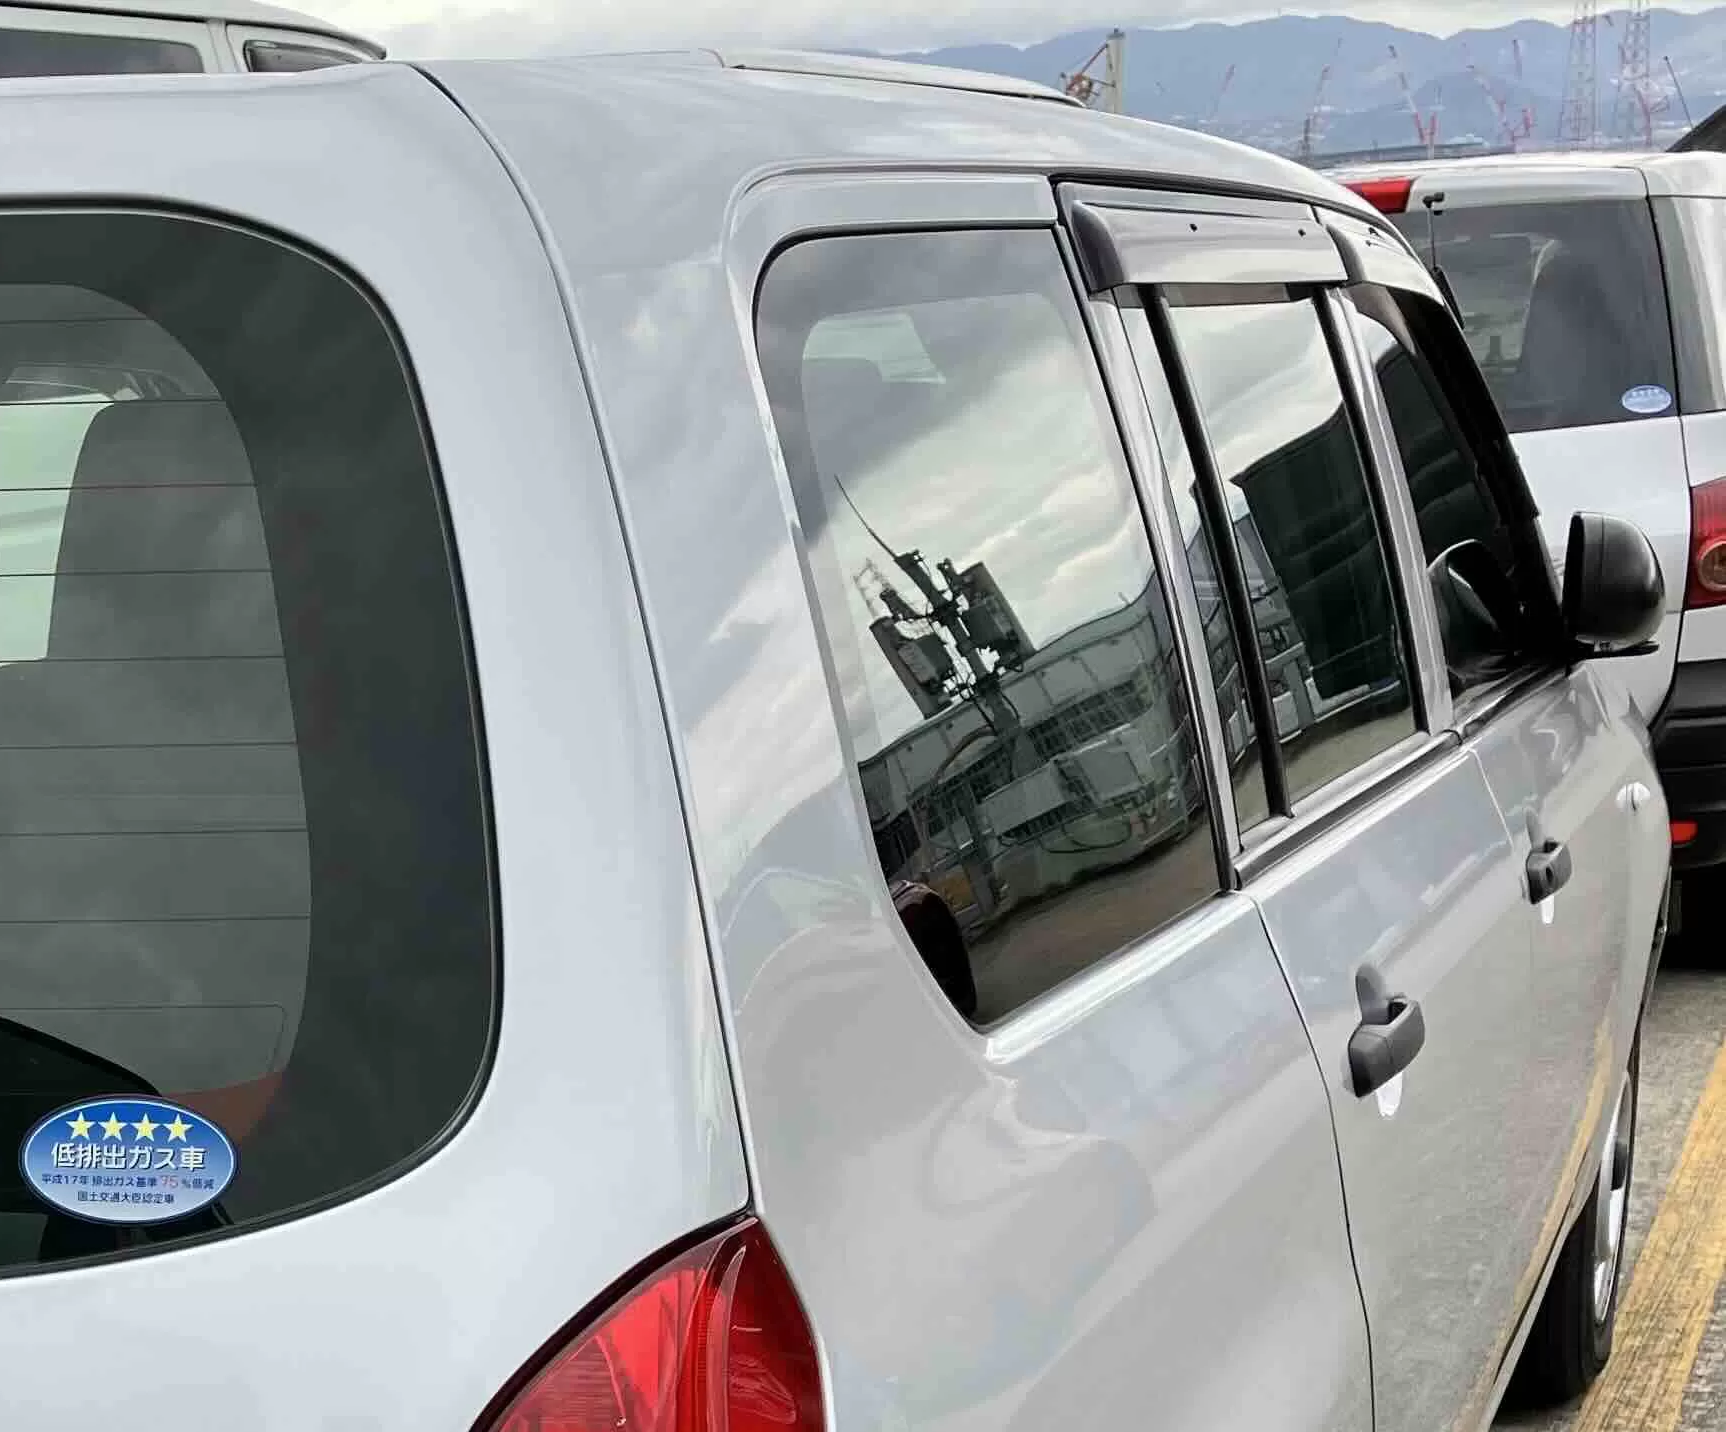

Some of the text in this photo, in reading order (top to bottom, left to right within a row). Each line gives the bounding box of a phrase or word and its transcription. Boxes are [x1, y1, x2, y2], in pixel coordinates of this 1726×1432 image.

[51, 1142, 206, 1171] 低排出ガス車
